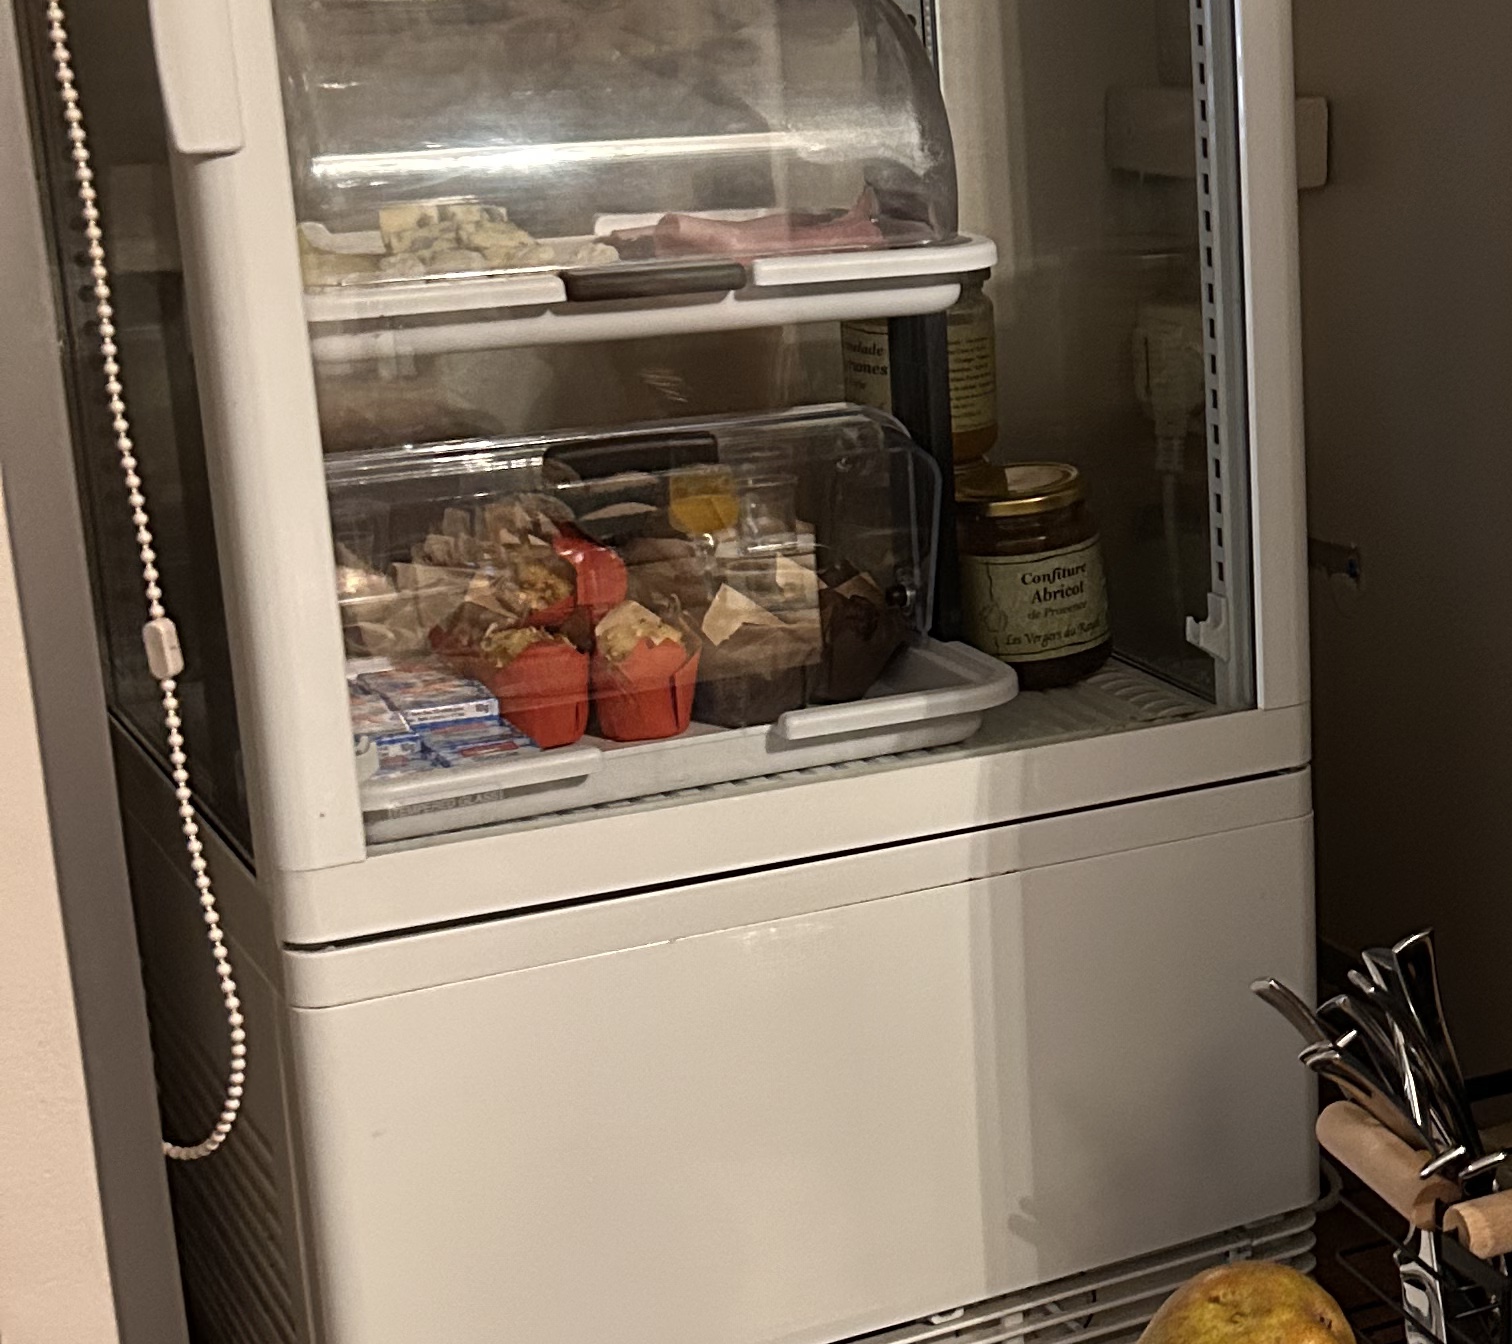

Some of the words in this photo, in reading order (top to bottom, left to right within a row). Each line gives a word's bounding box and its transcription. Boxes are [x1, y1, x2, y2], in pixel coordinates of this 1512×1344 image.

[1020, 563, 1087, 585] Confiture
[1031, 580, 1084, 605] Abricot
[458, 790, 501, 808] GLASS
